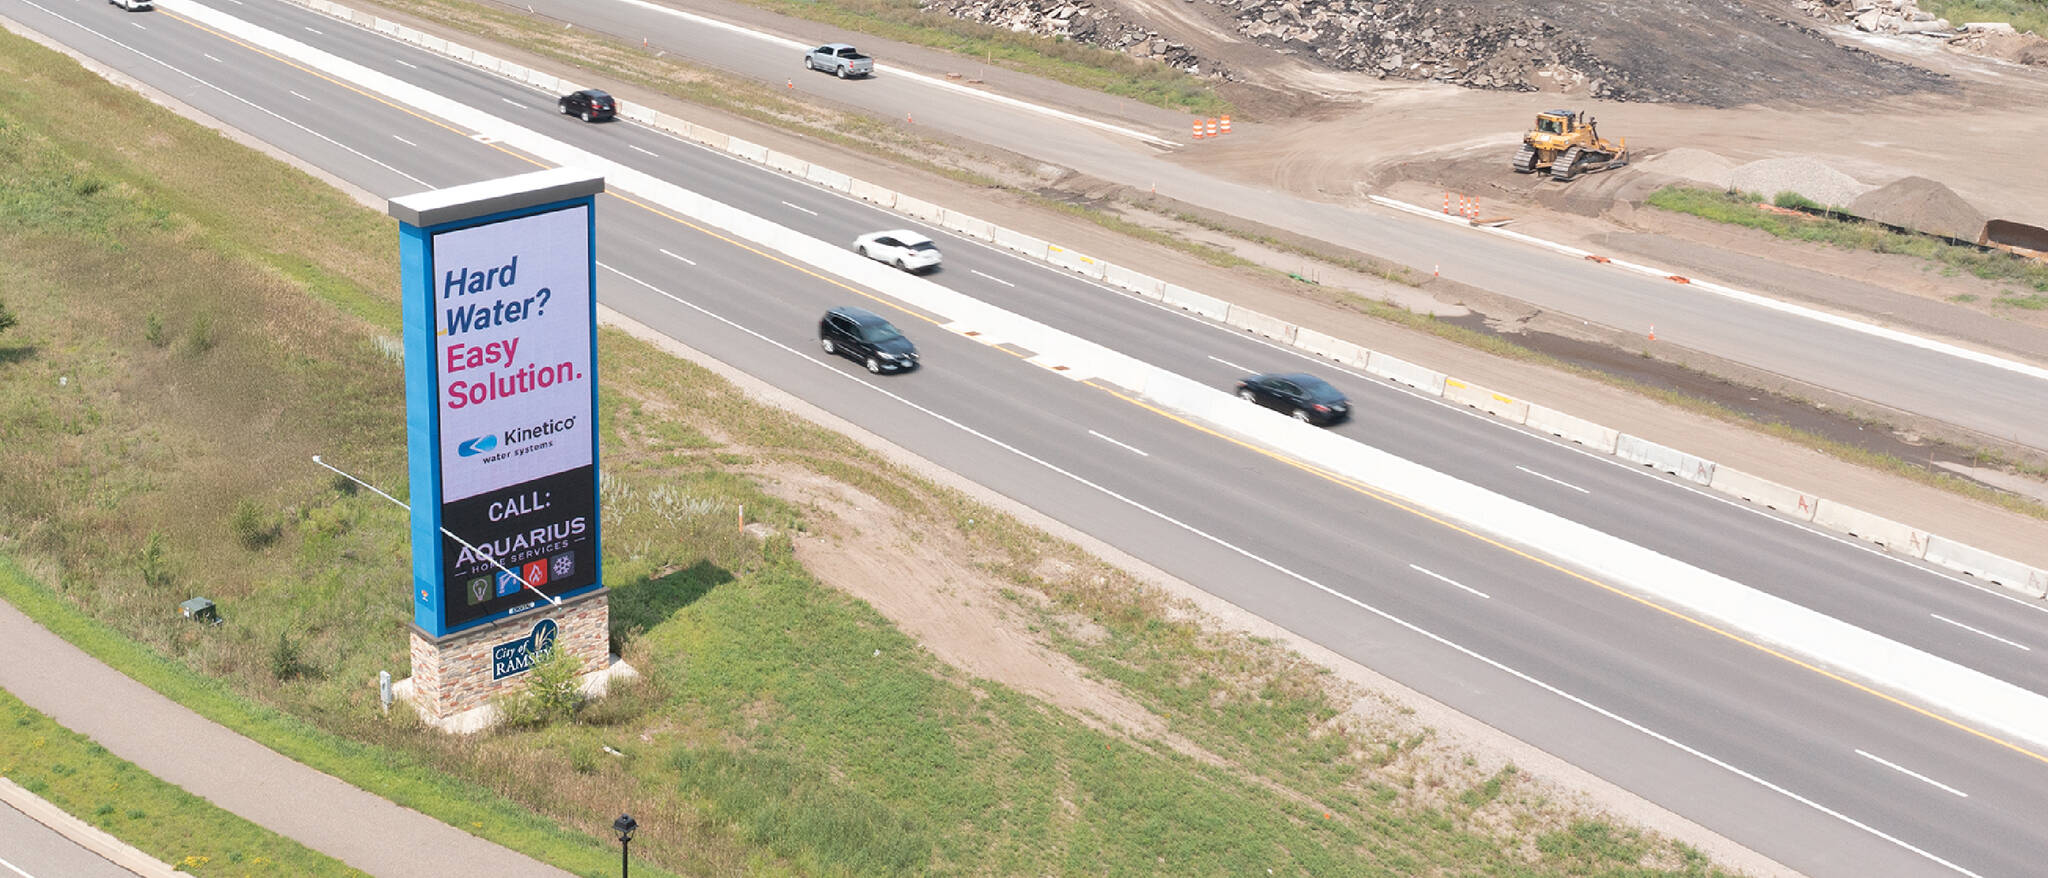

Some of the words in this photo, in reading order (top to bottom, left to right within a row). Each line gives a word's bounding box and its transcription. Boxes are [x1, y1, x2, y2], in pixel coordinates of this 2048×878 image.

[443, 255, 518, 299] Hard
[446, 287, 551, 336] Water?
[447, 337, 519, 373] Easy
[447, 361, 582, 410] Solution.
[504, 417, 576, 446] Kinetico
[482, 451, 511, 464] water
[514, 440, 553, 456] systems
[488, 491, 551, 522] CALL:
[455, 517, 586, 568] AQUARIUS
[510, 540, 569, 563] SERVICES
[495, 647, 516, 660] City
[518, 640, 529, 656] of
